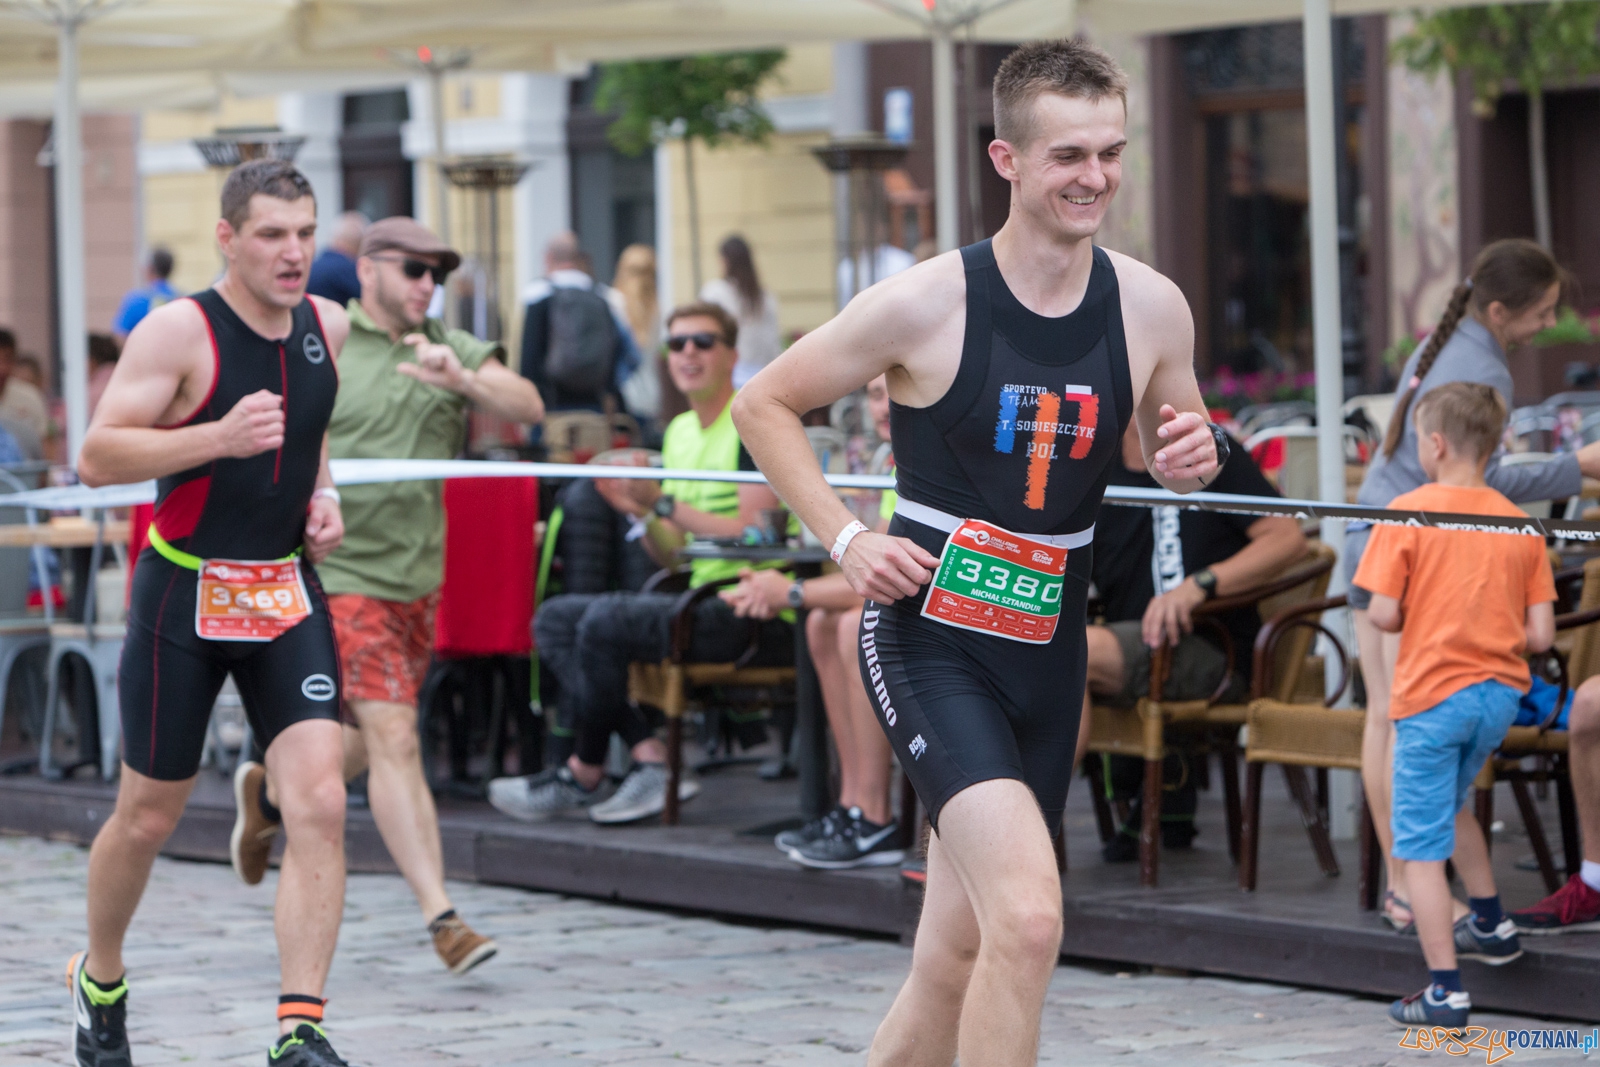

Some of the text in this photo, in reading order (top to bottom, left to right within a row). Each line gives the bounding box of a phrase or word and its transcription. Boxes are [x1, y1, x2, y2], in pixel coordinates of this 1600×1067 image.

[1003, 383, 1048, 396] SPORTEVO
[1008, 395, 1040, 408] TEAM
[1016, 420, 1096, 439] SOBIESZCZYK
[1025, 441, 1059, 460] POL
[956, 557, 1062, 604] 3380
[970, 587, 1000, 603] MICHAŁ
[1001, 595, 1042, 613] SZTANDUR
